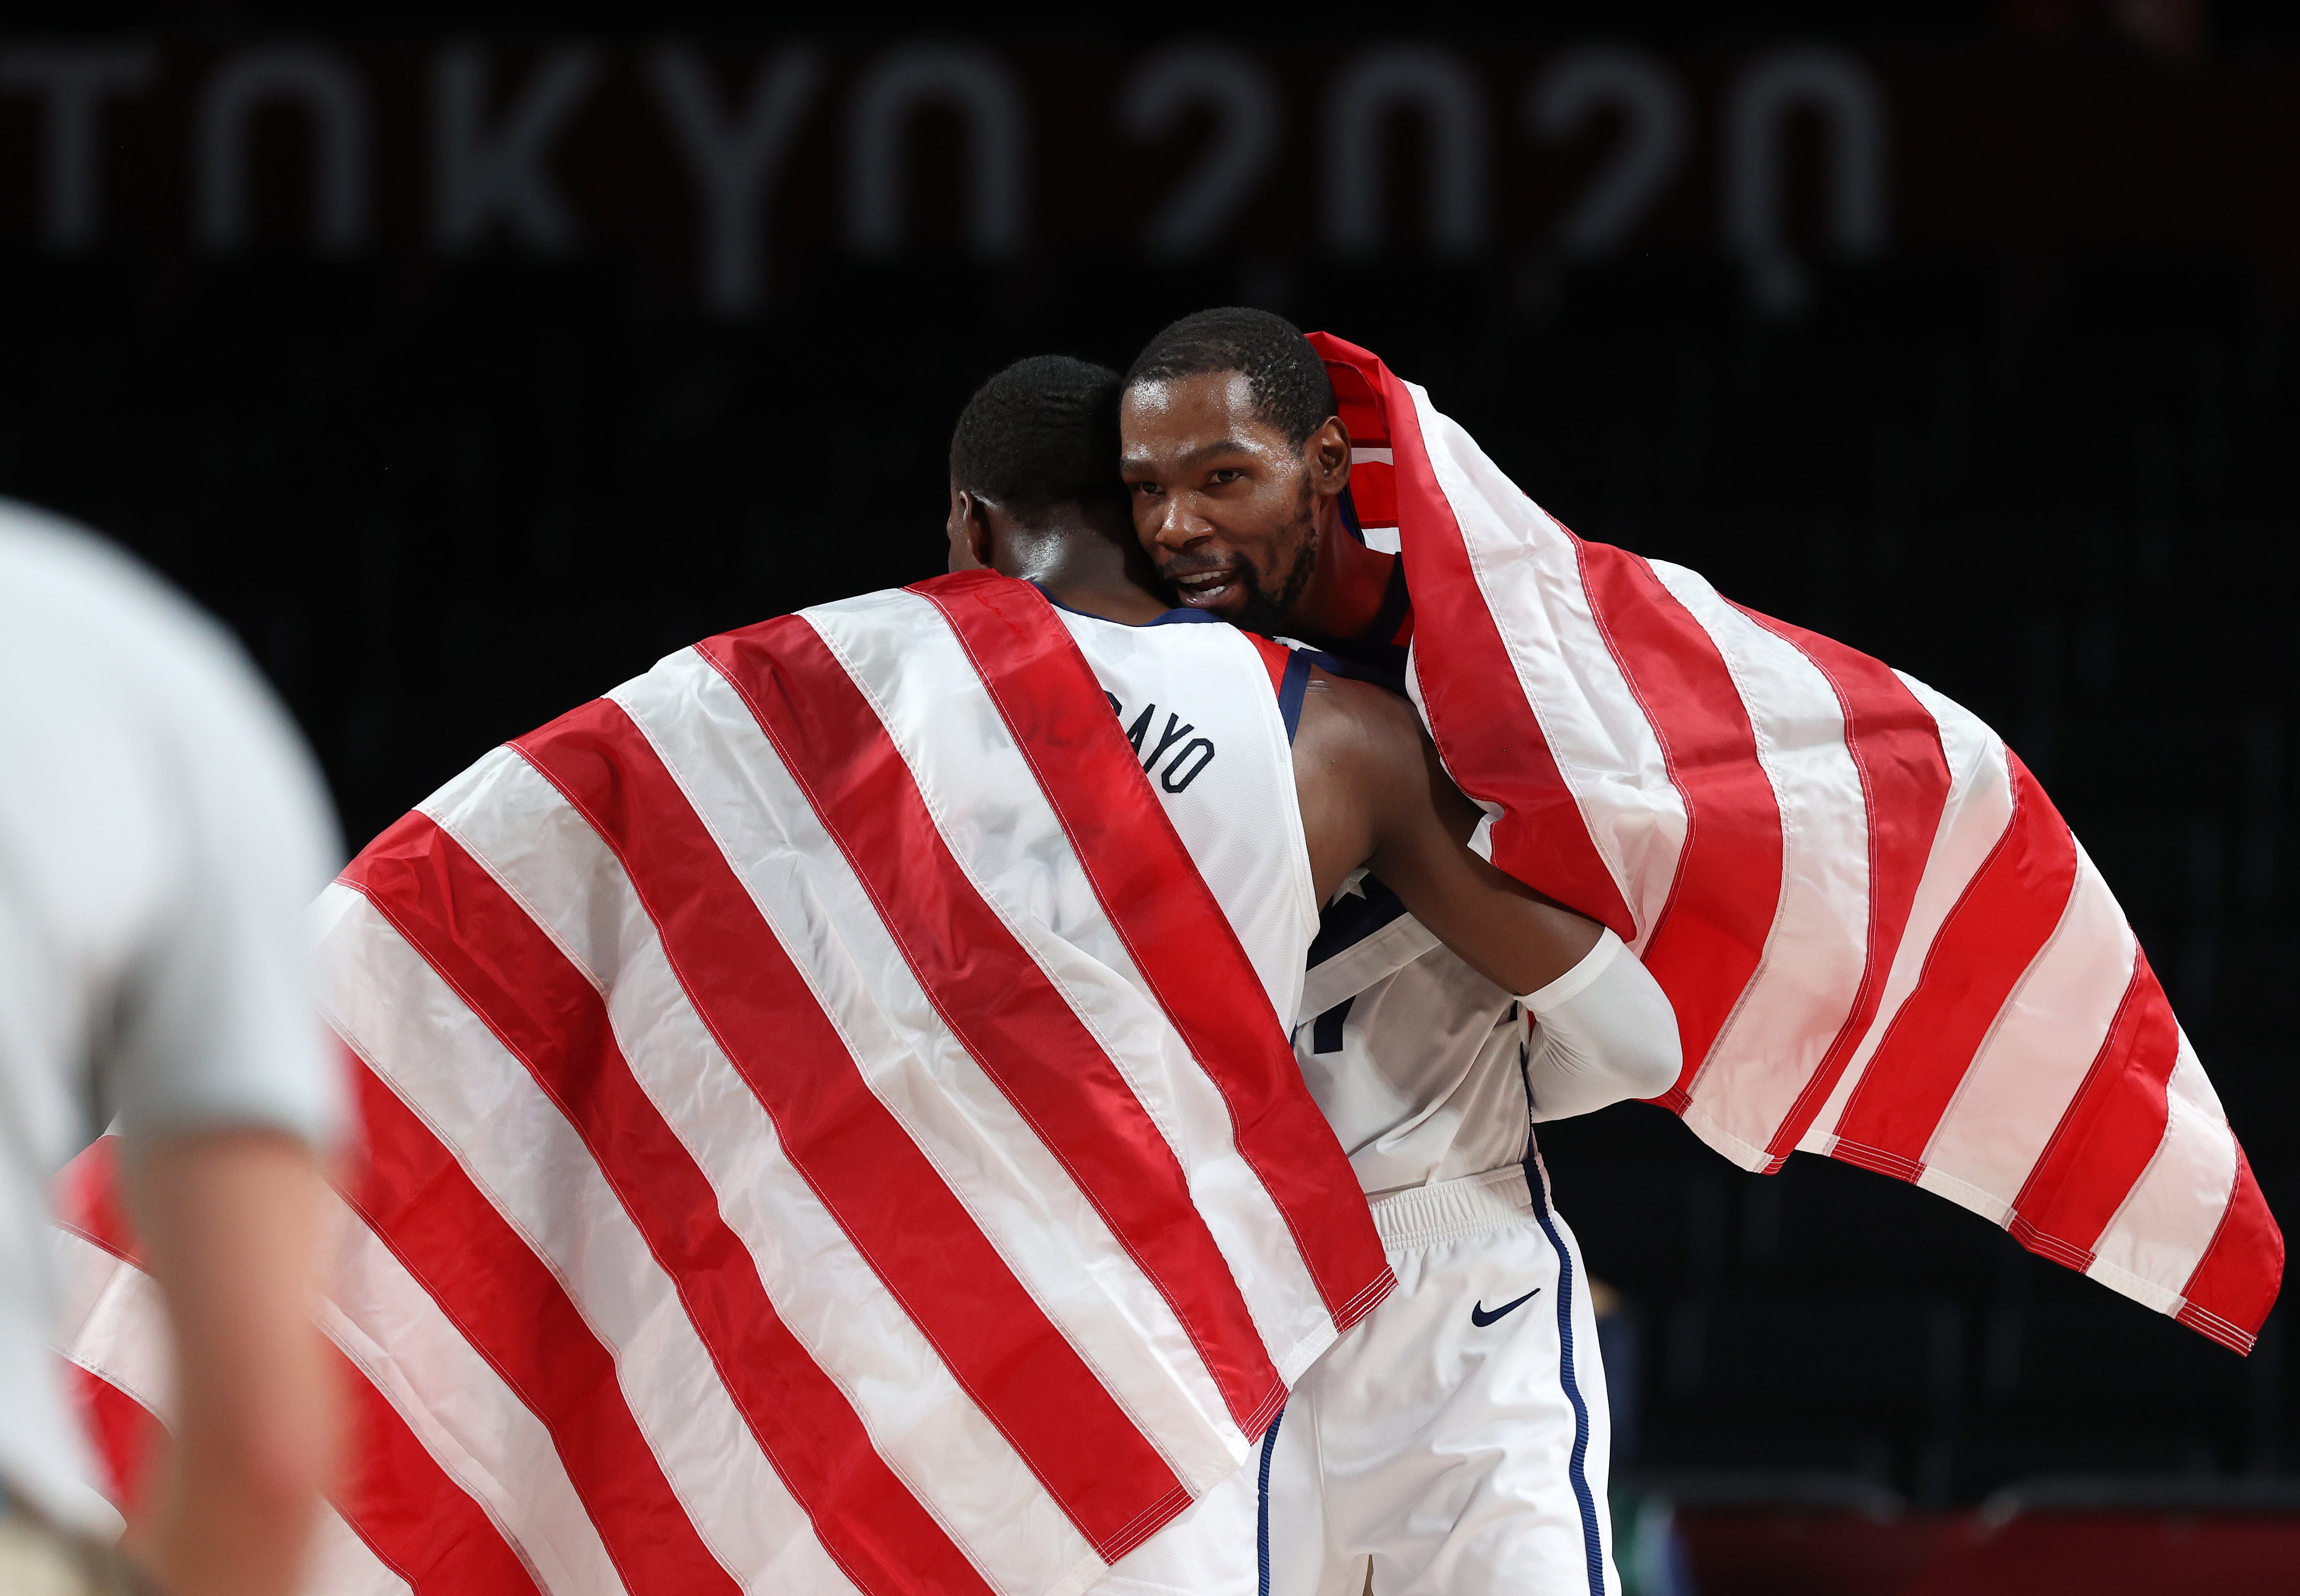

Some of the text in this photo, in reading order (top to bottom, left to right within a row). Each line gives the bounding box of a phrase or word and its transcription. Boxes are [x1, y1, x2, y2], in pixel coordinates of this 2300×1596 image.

[0, 39, 1892, 321] TOKYO 2020
[1103, 689, 1215, 793] AYO
